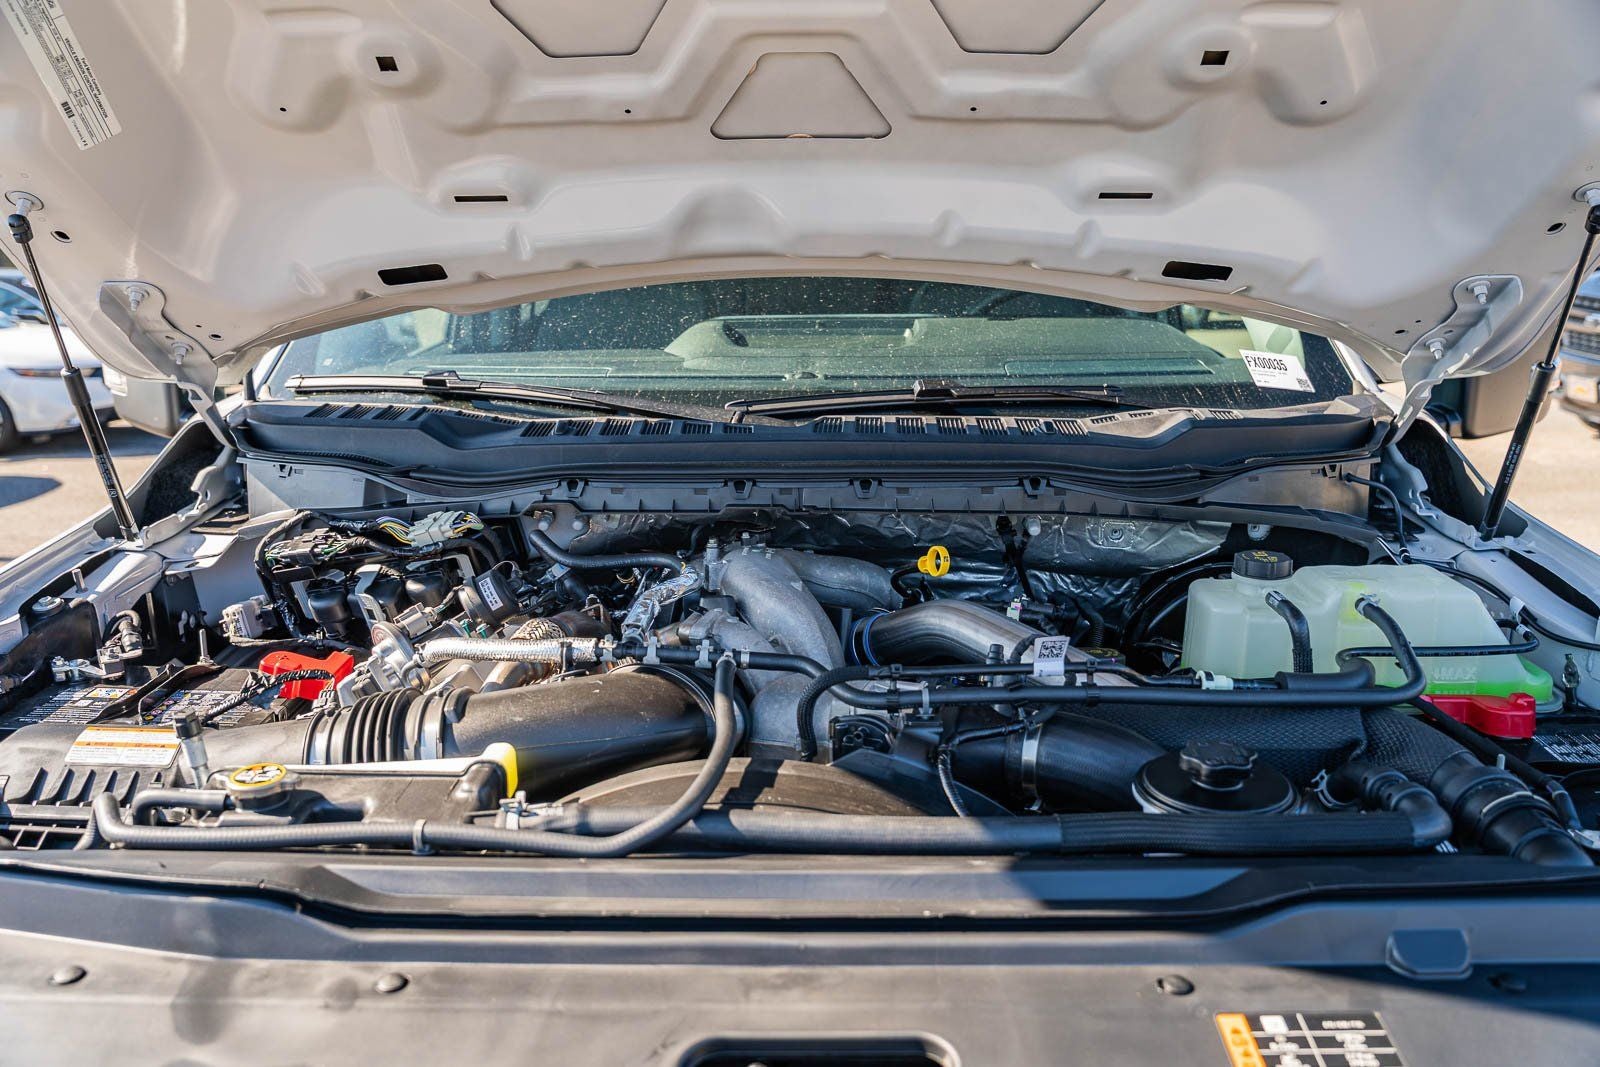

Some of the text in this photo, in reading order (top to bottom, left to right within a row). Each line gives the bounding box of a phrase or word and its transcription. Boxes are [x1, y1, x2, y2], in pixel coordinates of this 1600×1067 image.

[64, 38, 76, 55] VEHICLE
[73, 55, 86, 75] EMISSION
[83, 74, 96, 93] CONTROL
[93, 93, 109, 118] INFORMATION
[1245, 355, 1288, 371] FX00035
